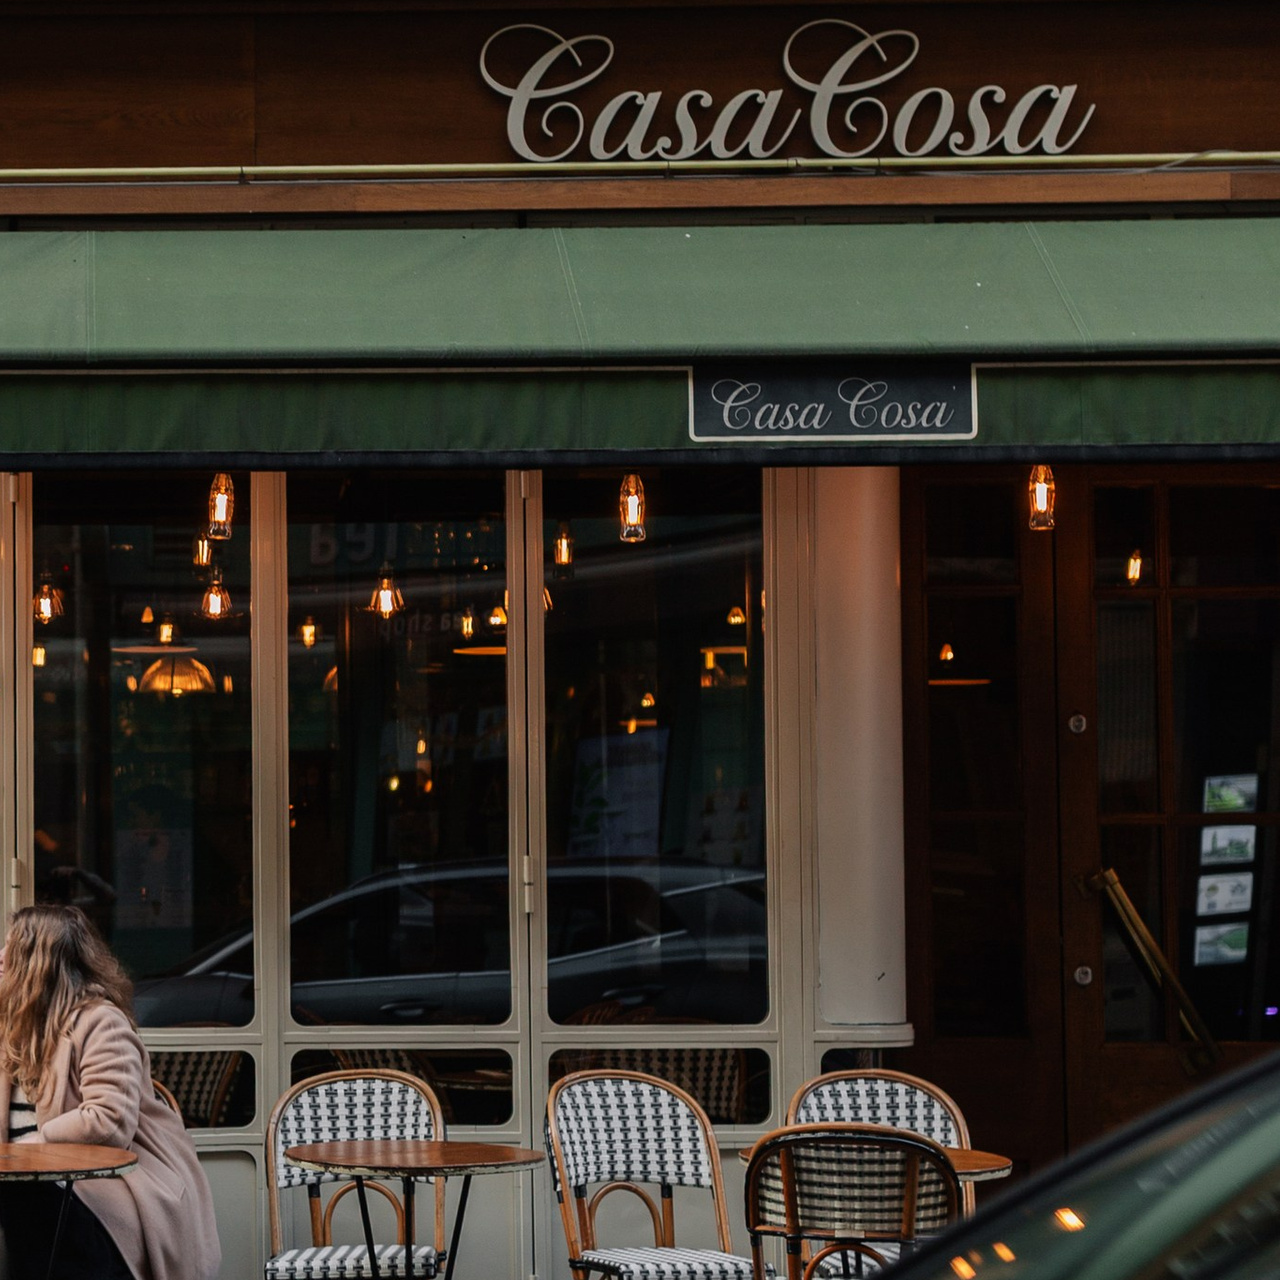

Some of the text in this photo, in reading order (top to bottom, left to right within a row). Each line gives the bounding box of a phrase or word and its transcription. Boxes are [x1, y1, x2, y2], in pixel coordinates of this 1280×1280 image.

[479, 19, 1096, 163] Casa Cosa
[711, 377, 955, 430] Casa Cosa
